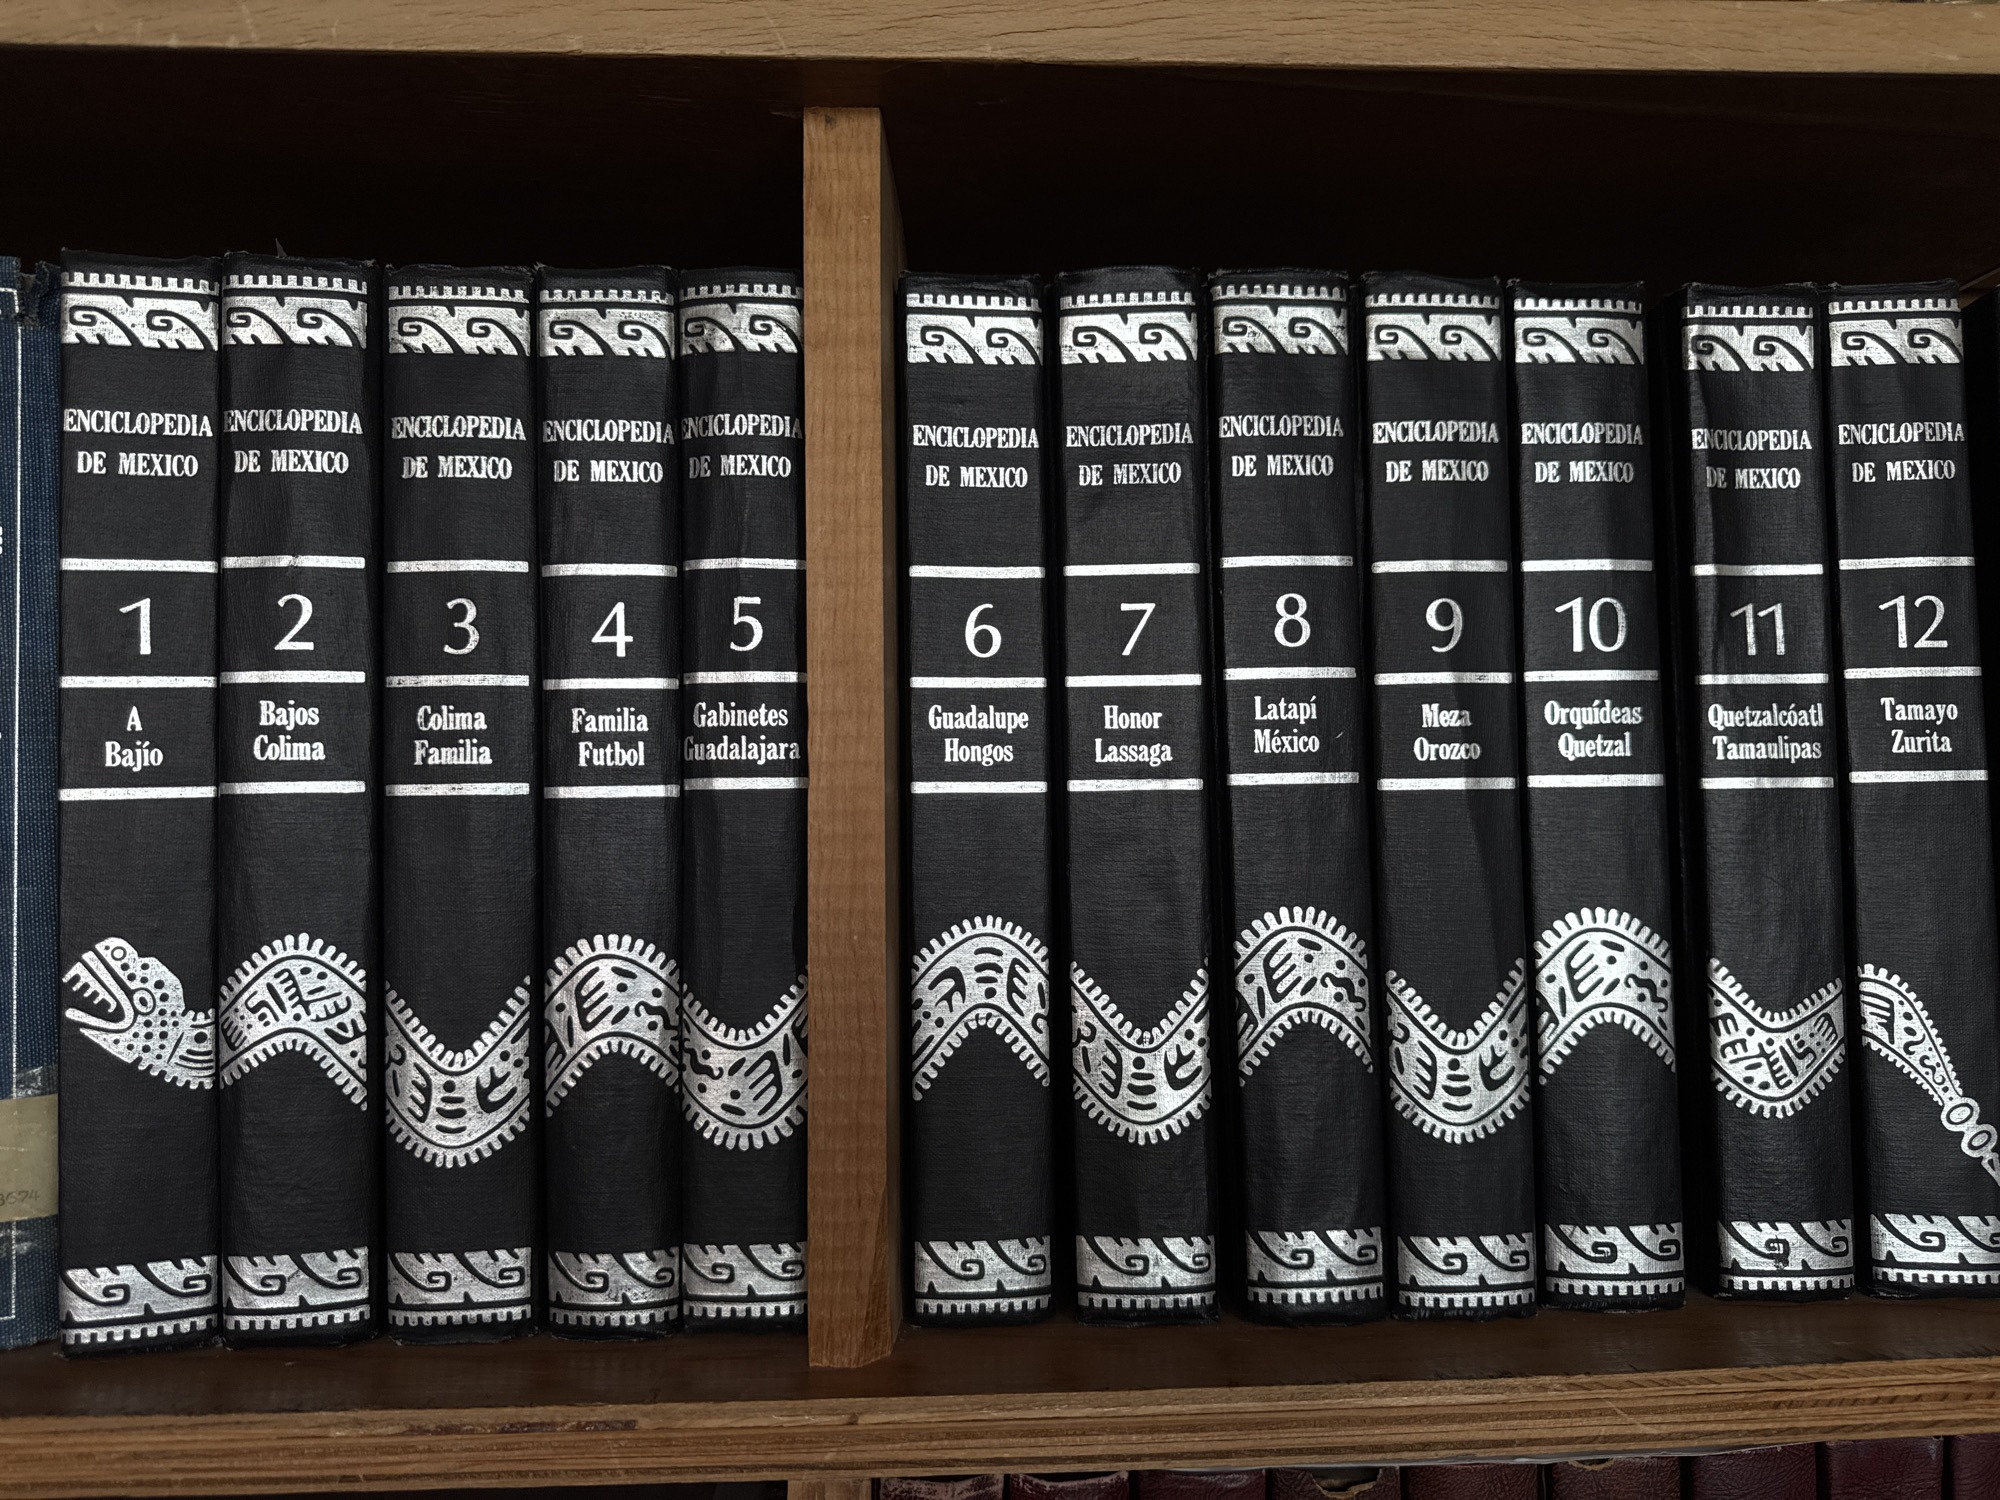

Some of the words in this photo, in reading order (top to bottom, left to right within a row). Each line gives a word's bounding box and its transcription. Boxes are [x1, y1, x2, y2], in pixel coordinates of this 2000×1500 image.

[63, 407, 214, 438] ENCICLOPEDIA
[223, 408, 364, 435] ENCICLOPEDIA
[391, 414, 527, 441] ENCICLOPEDIA
[544, 418, 673, 444] ENCICLOPEDIA
[681, 413, 804, 441] ENCICLOPEDIA
[1065, 422, 1194, 448] ENCICLOPEDIA
[1218, 414, 1344, 439] ENCICLOPEDIA
[1372, 419, 1499, 445] ENCICLOPEDIA
[1520, 421, 1643, 445] ENCICLOPEDIA
[1837, 421, 1965, 446] ENCICLOPEDIA
[912, 424, 1040, 449] ENCICLOPEDIA
[1690, 427, 1813, 451] ENCICLOPEDIA
[76, 450, 107, 475] DE
[117, 451, 199, 478] MEXICO
[234, 449, 261, 473] DE
[270, 448, 350, 474] MEXICO
[401, 455, 429, 479] DE
[437, 455, 513, 480] MEXICO
[553, 459, 580, 483] DE
[589, 459, 664, 484] MEXICO
[689, 455, 711, 478] DE
[720, 454, 792, 478] MEXICO
[1078, 464, 1104, 487] DE
[1112, 461, 1182, 485] MEXICO
[1231, 454, 1258, 477] DE
[1266, 454, 1334, 477] MEXICO
[1385, 459, 1413, 483] DE
[1421, 458, 1490, 482] MEXICO
[1534, 460, 1561, 484] DE
[1568, 459, 1634, 483] MEXICO
[1851, 461, 1877, 483] DE
[1885, 459, 1956, 482] MEXICO
[925, 464, 951, 487] DE
[959, 465, 1029, 489] MEXICO
[1705, 466, 1727, 488] DE
[1734, 467, 1802, 490] MEXICO
[118, 597, 152, 656] 1
[273, 593, 315, 651] 2
[443, 597, 480, 655] 3
[590, 601, 634, 658] 4
[729, 595, 764, 652] 5
[964, 602, 1002, 659] 6
[1120, 602, 1157, 657] 7
[1273, 592, 1311, 648] 8
[1425, 597, 1463, 653] 9
[1554, 596, 1627, 653] 10
[1730, 602, 1786, 656] 11
[1878, 594, 1949, 649] 12
[126, 705, 143, 732] A
[258, 699, 320, 732] Bajos
[416, 704, 488, 732] Colima
[571, 706, 650, 734] Familia
[693, 701, 789, 728] Gabinetes
[927, 704, 1030, 735] Guadalupe
[1103, 704, 1164, 730] Honor
[1253, 695, 1318, 725] Latapí
[1421, 702, 1472, 729] Meza
[1543, 698, 1643, 731] Orquídeas
[1707, 702, 1824, 732] Quetzalcóatl
[1879, 696, 1959, 726] Tamayo
[252, 734, 327, 761] Colima
[413, 737, 493, 766] Familia
[577, 740, 646, 768] Futbol
[683, 734, 802, 766] Guadalajara
[943, 737, 1015, 767] Hongos
[1094, 737, 1174, 768] Lassaga
[1253, 728, 1321, 754] México
[1413, 736, 1481, 762] Orozco
[1557, 730, 1632, 762] Quetzal
[1711, 735, 1822, 764] Tamaulipas
[1891, 728, 1953, 754] Zurita
[104, 739, 164, 773] Bajío
